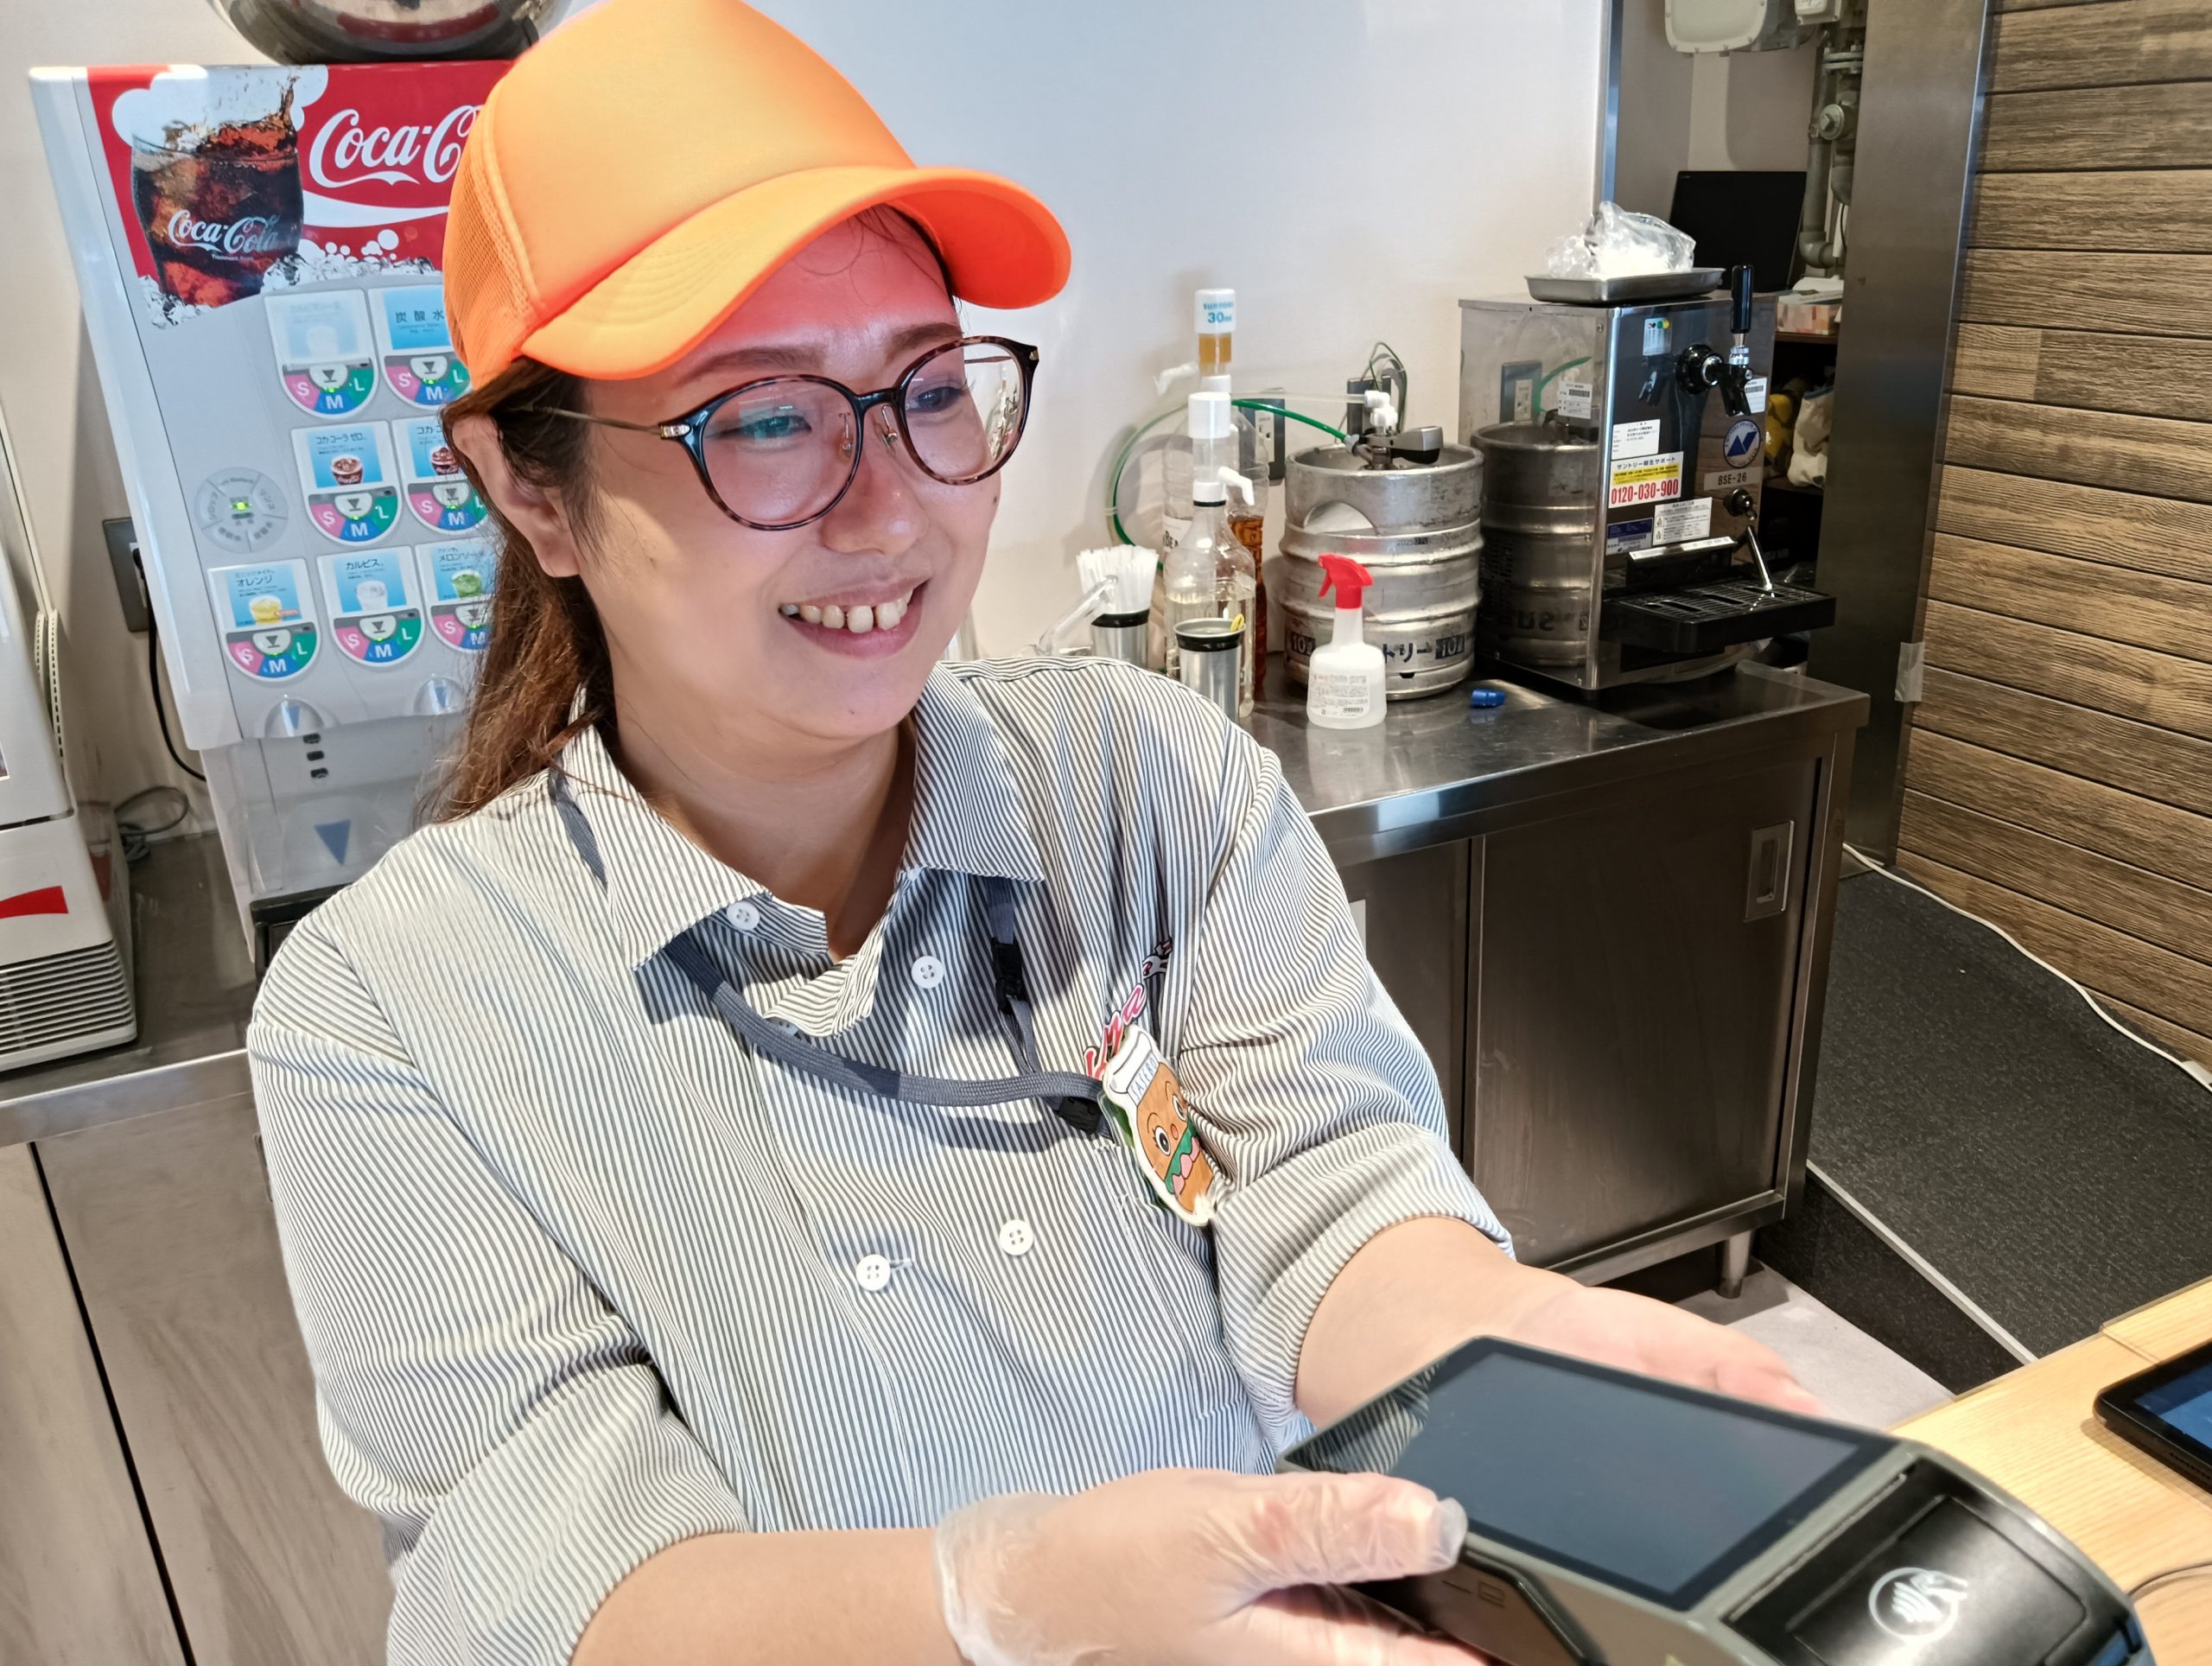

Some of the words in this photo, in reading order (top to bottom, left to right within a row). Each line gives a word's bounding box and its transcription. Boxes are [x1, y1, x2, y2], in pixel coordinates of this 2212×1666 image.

[308, 105, 484, 188] Coca-C
[168, 209, 281, 254] Coca-Cola
[395, 309, 444, 323] 炭酸水
[354, 377, 365, 391] L
[398, 373, 412, 387] S
[453, 370, 463, 384] L
[296, 380, 311, 397] S
[427, 386, 442, 401] M
[326, 395, 343, 409] M
[1718, 472, 1747, 486] BSE-26
[1611, 479, 1679, 505] 0120-030-900
[378, 506, 389, 519] L
[421, 500, 434, 513] S
[321, 511, 335, 527] S
[448, 512, 465, 525] M
[352, 523, 367, 537] M
[346, 559, 379, 570] カルピス
[237, 575, 273, 587] オレンジ
[402, 626, 412, 640] L
[443, 620, 456, 635] S
[347, 633, 360, 649] S
[469, 632, 486, 645] M
[296, 641, 308, 656] L
[375, 644, 392, 658] M
[1383, 642, 1432, 664] トリー
[242, 648, 254, 664] S
[269, 659, 286, 673] M
